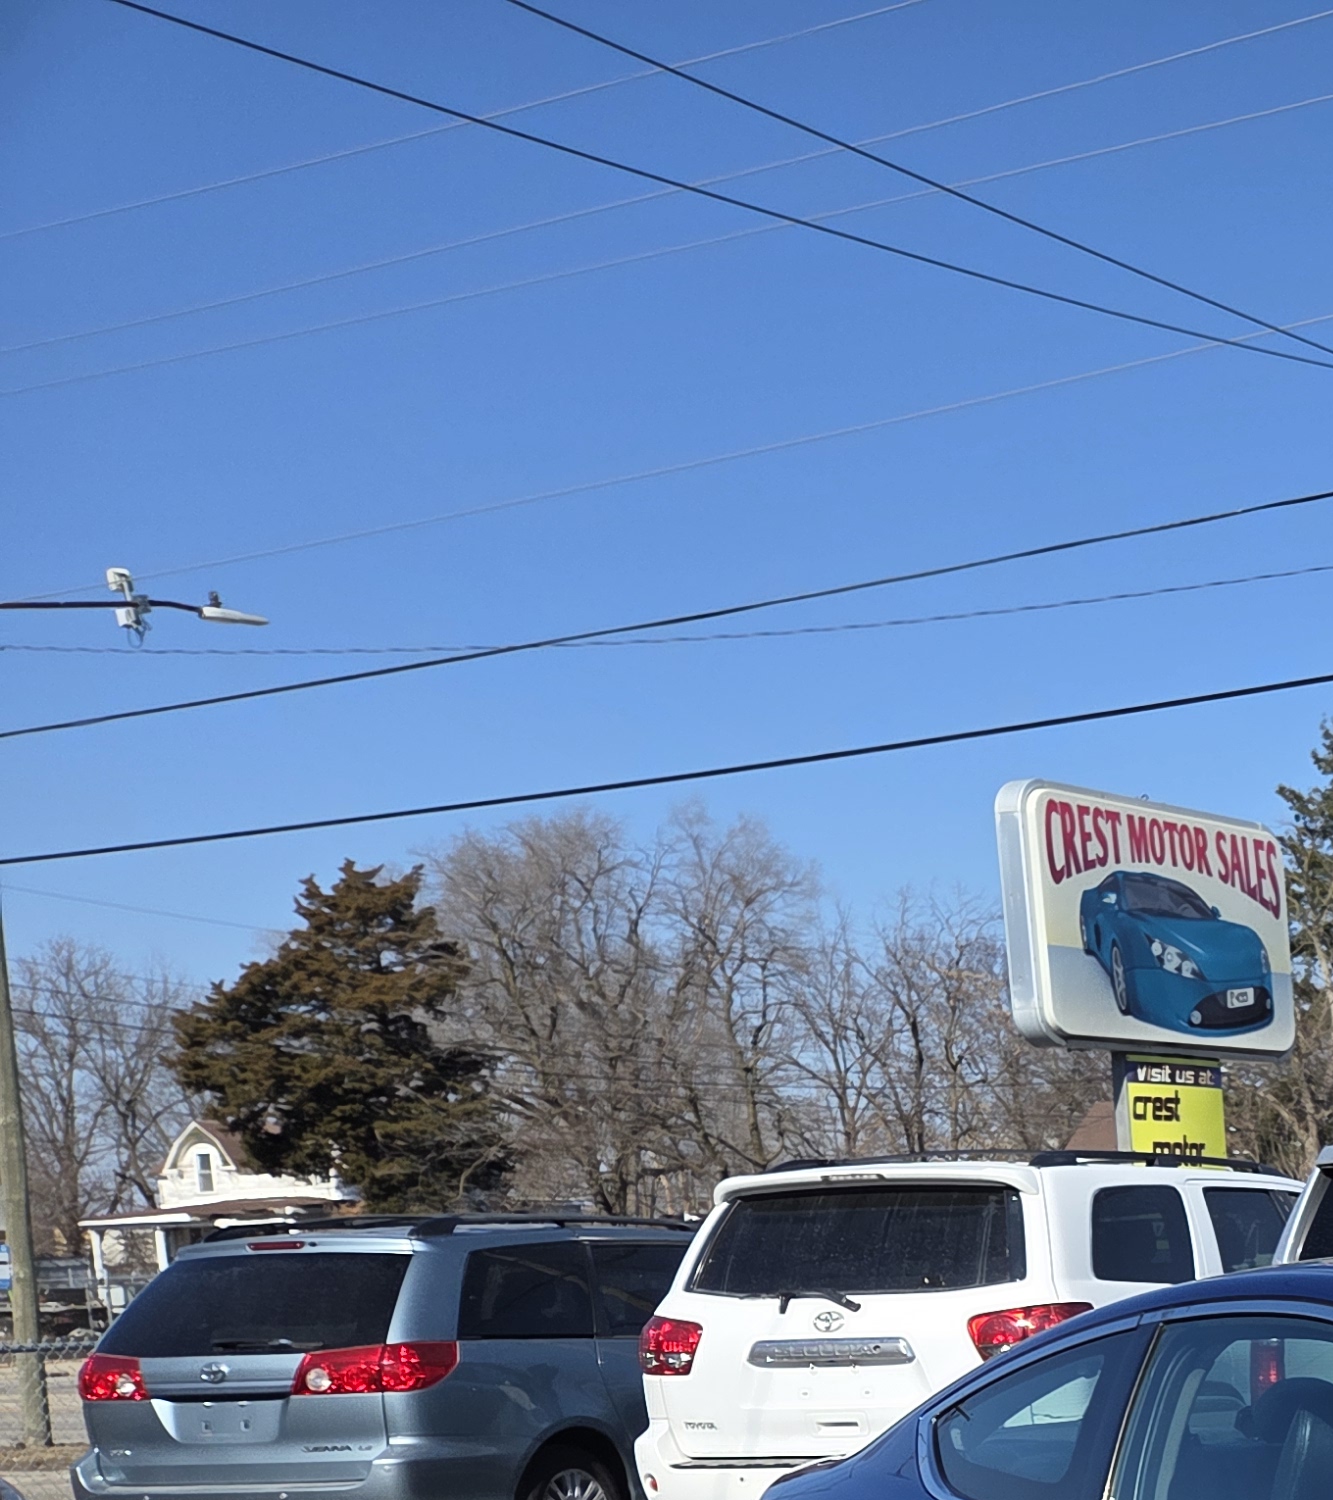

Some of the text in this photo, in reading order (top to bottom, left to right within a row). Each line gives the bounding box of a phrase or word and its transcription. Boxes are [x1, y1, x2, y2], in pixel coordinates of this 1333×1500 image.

[1045, 798, 1281, 920] CREST MOTOR SALES
[1175, 1069, 1196, 1083] us
[1198, 1069, 1216, 1085] at
[1133, 1089, 1181, 1122] crest
